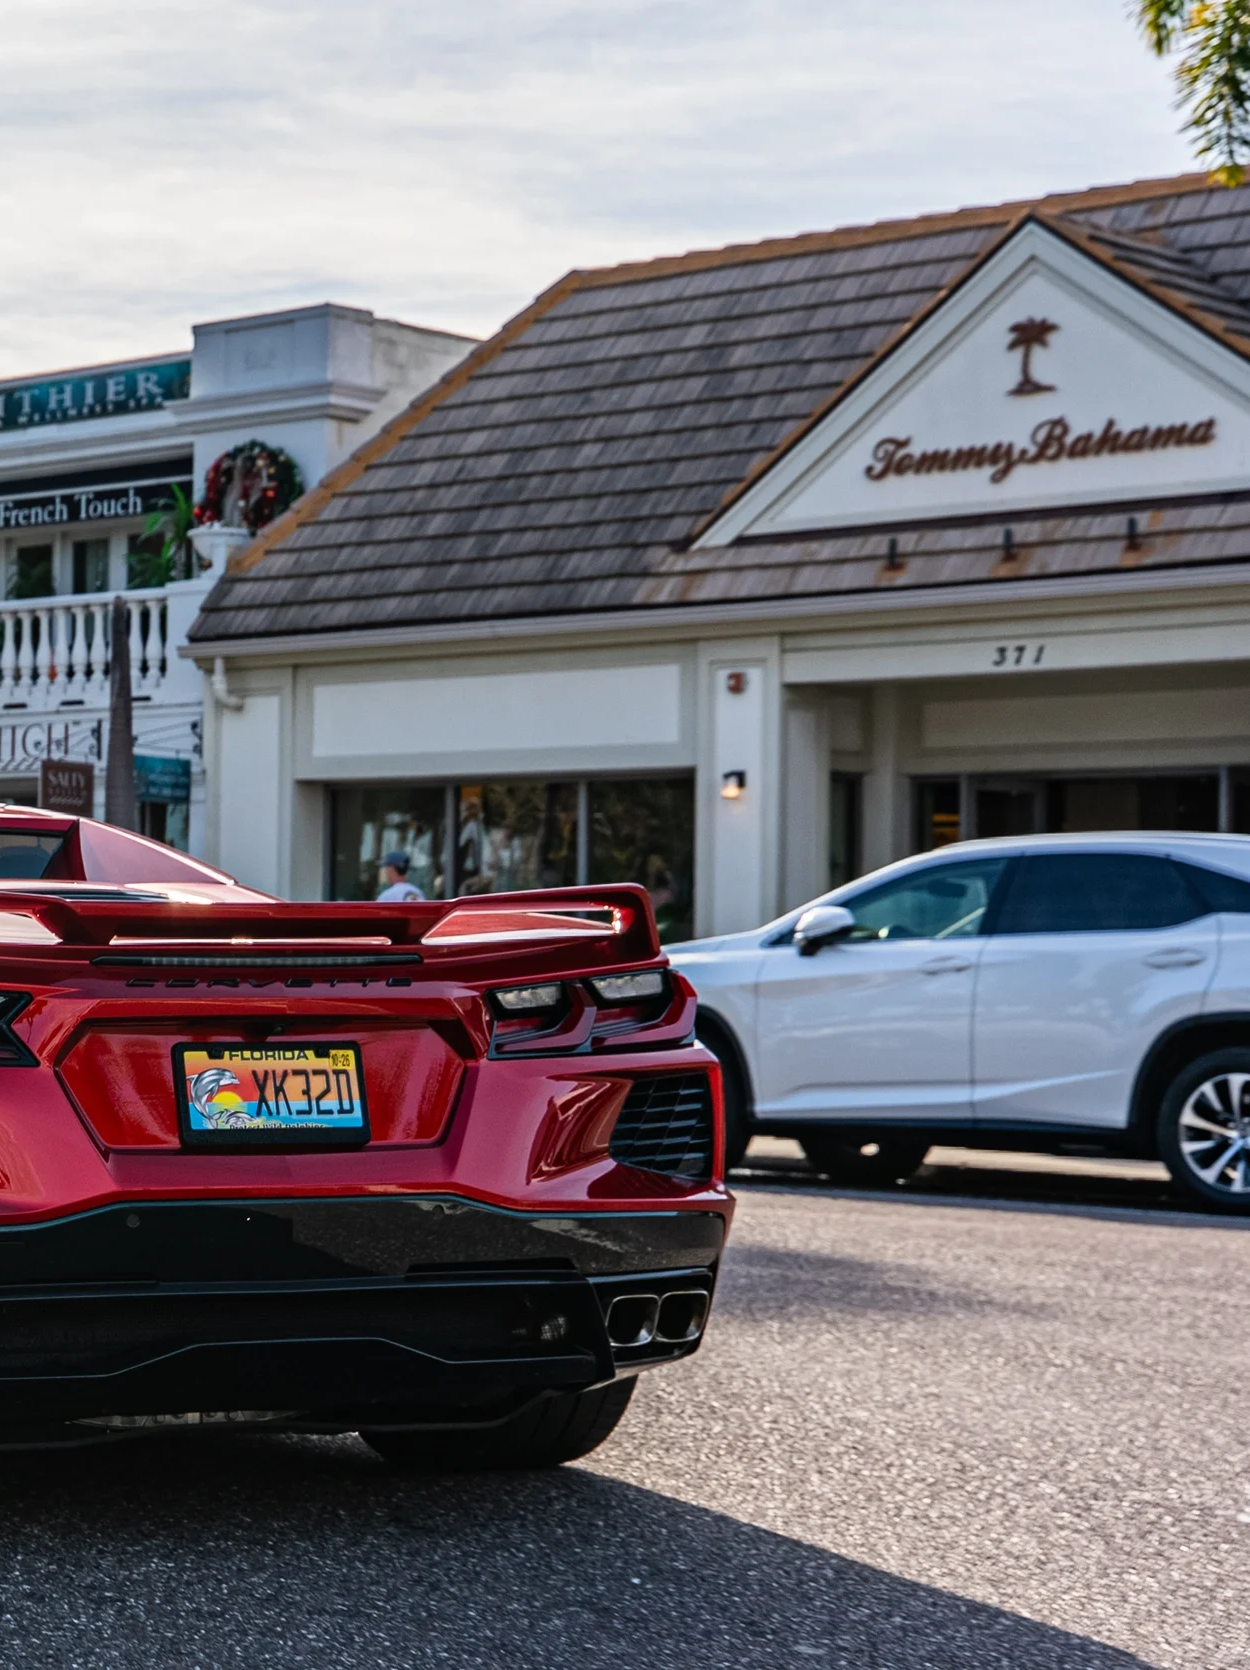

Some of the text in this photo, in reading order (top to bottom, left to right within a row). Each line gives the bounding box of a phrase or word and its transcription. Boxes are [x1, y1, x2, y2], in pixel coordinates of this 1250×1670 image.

[865, 415, 1217, 484] Tommy Bahama
[74, 487, 143, 519] Touch
[992, 643, 1046, 667] 371
[125, 977, 413, 988] CORVETTE
[229, 1050, 309, 1061] FLORIDA
[251, 1069, 355, 1116] XK32D
